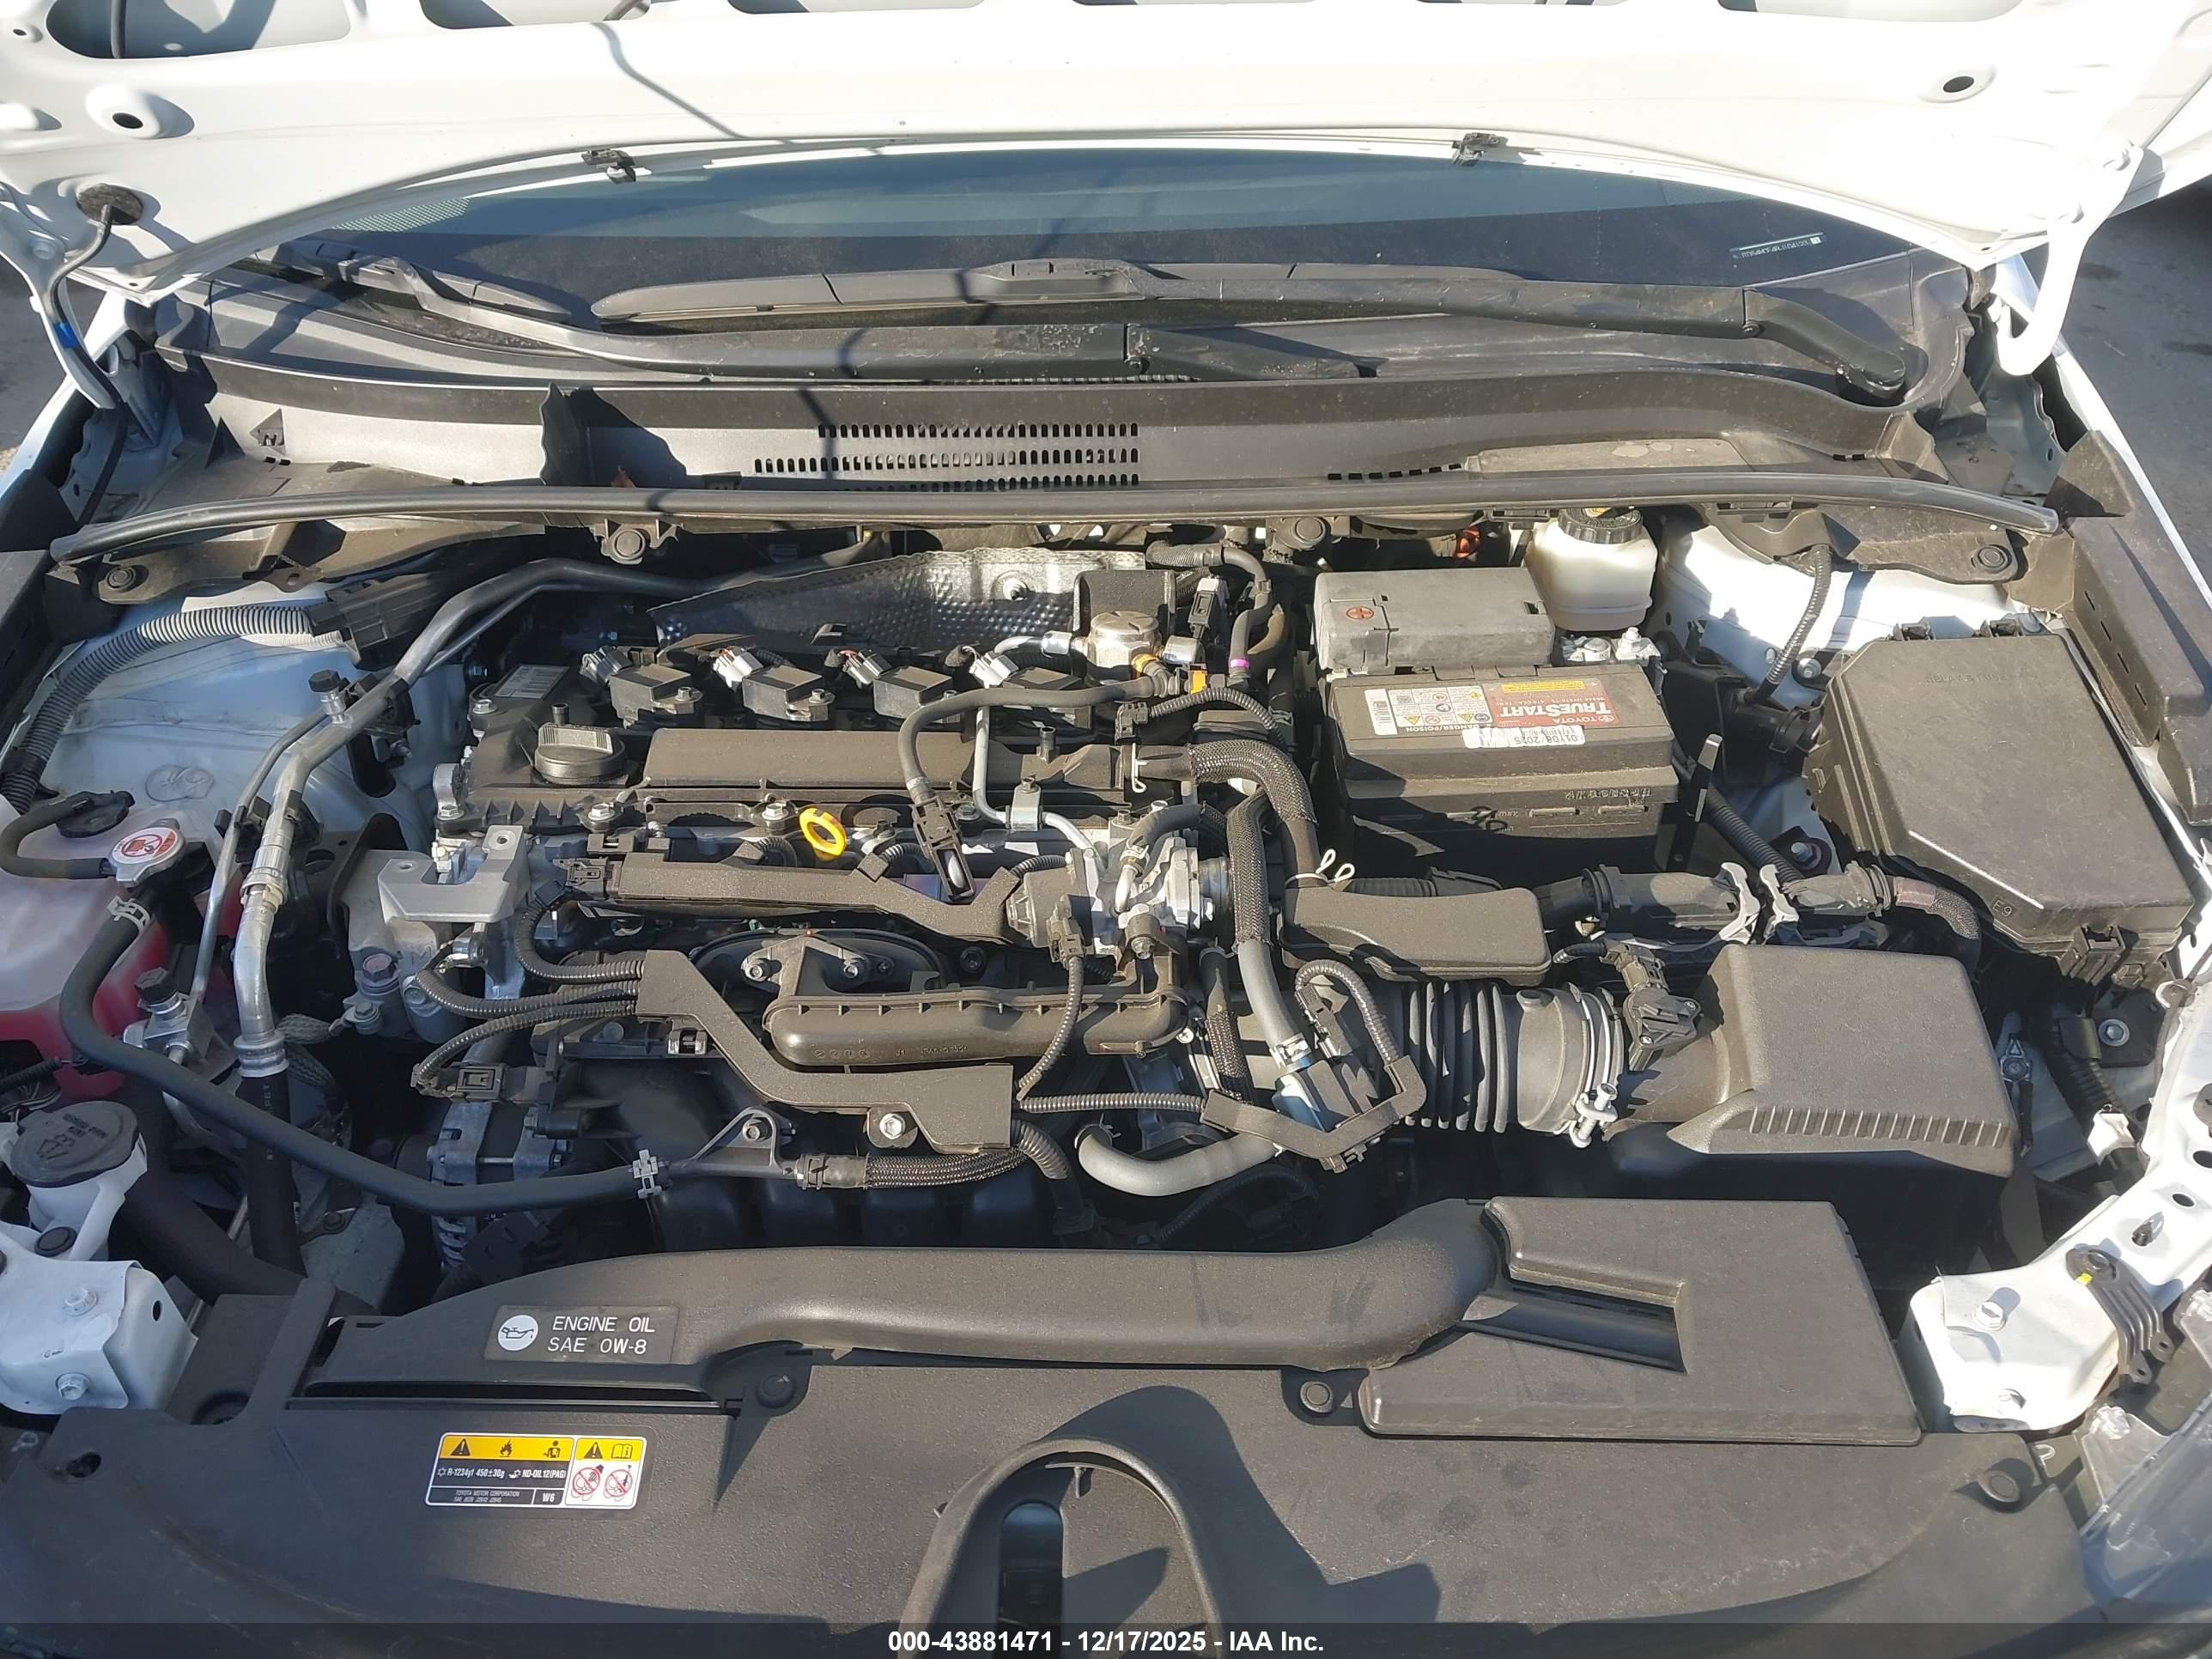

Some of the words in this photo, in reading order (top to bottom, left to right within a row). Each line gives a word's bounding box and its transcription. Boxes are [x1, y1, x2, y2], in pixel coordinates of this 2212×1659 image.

[1992, 899, 2013, 917] E9
[553, 1316, 618, 1332] ENGINE
[629, 1316, 656, 1333] OIL
[547, 1337, 588, 1352] SAE
[600, 1338, 647, 1355] 0W-8
[447, 1468, 475, 1479] R-1234yf
[475, 1468, 505, 1479] 450±30g
[542, 1492, 555, 1503] W6
